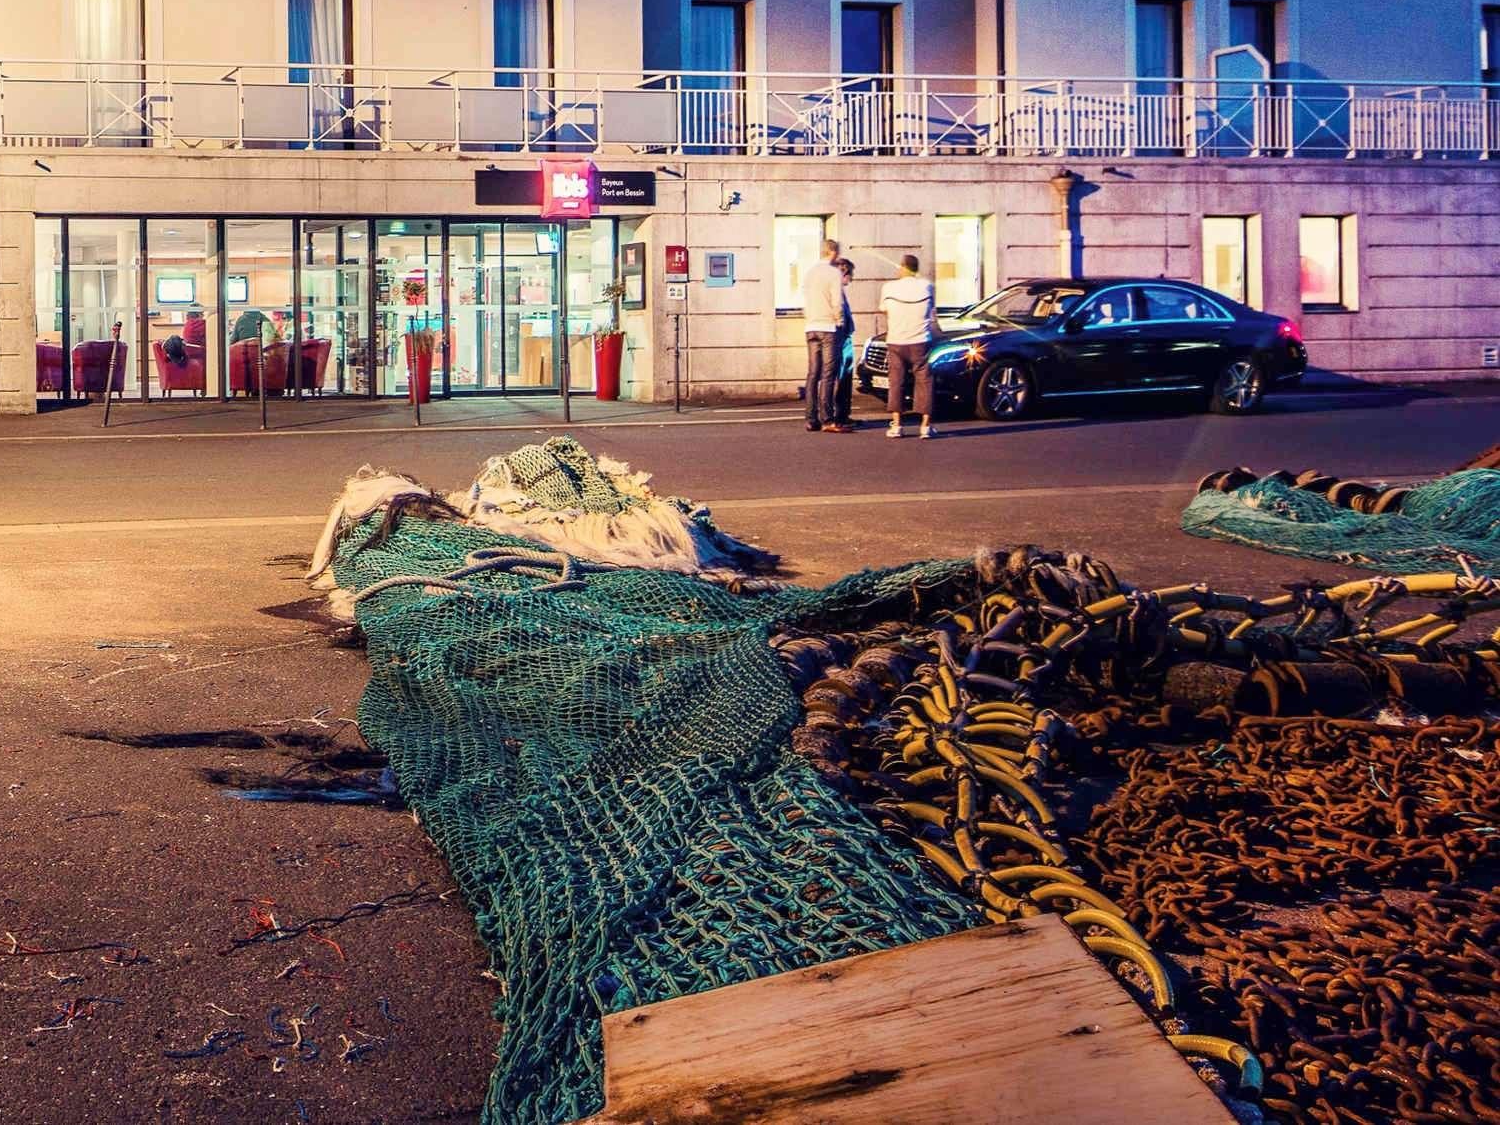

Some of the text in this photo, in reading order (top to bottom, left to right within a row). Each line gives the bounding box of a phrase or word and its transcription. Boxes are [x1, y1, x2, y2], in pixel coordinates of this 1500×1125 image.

[552, 172, 589, 199] ibis
[601, 178, 624, 187] Bayeux
[601, 188, 615, 196] Port
[625, 188, 645, 196] Bessin
[675, 251, 685, 262] H
